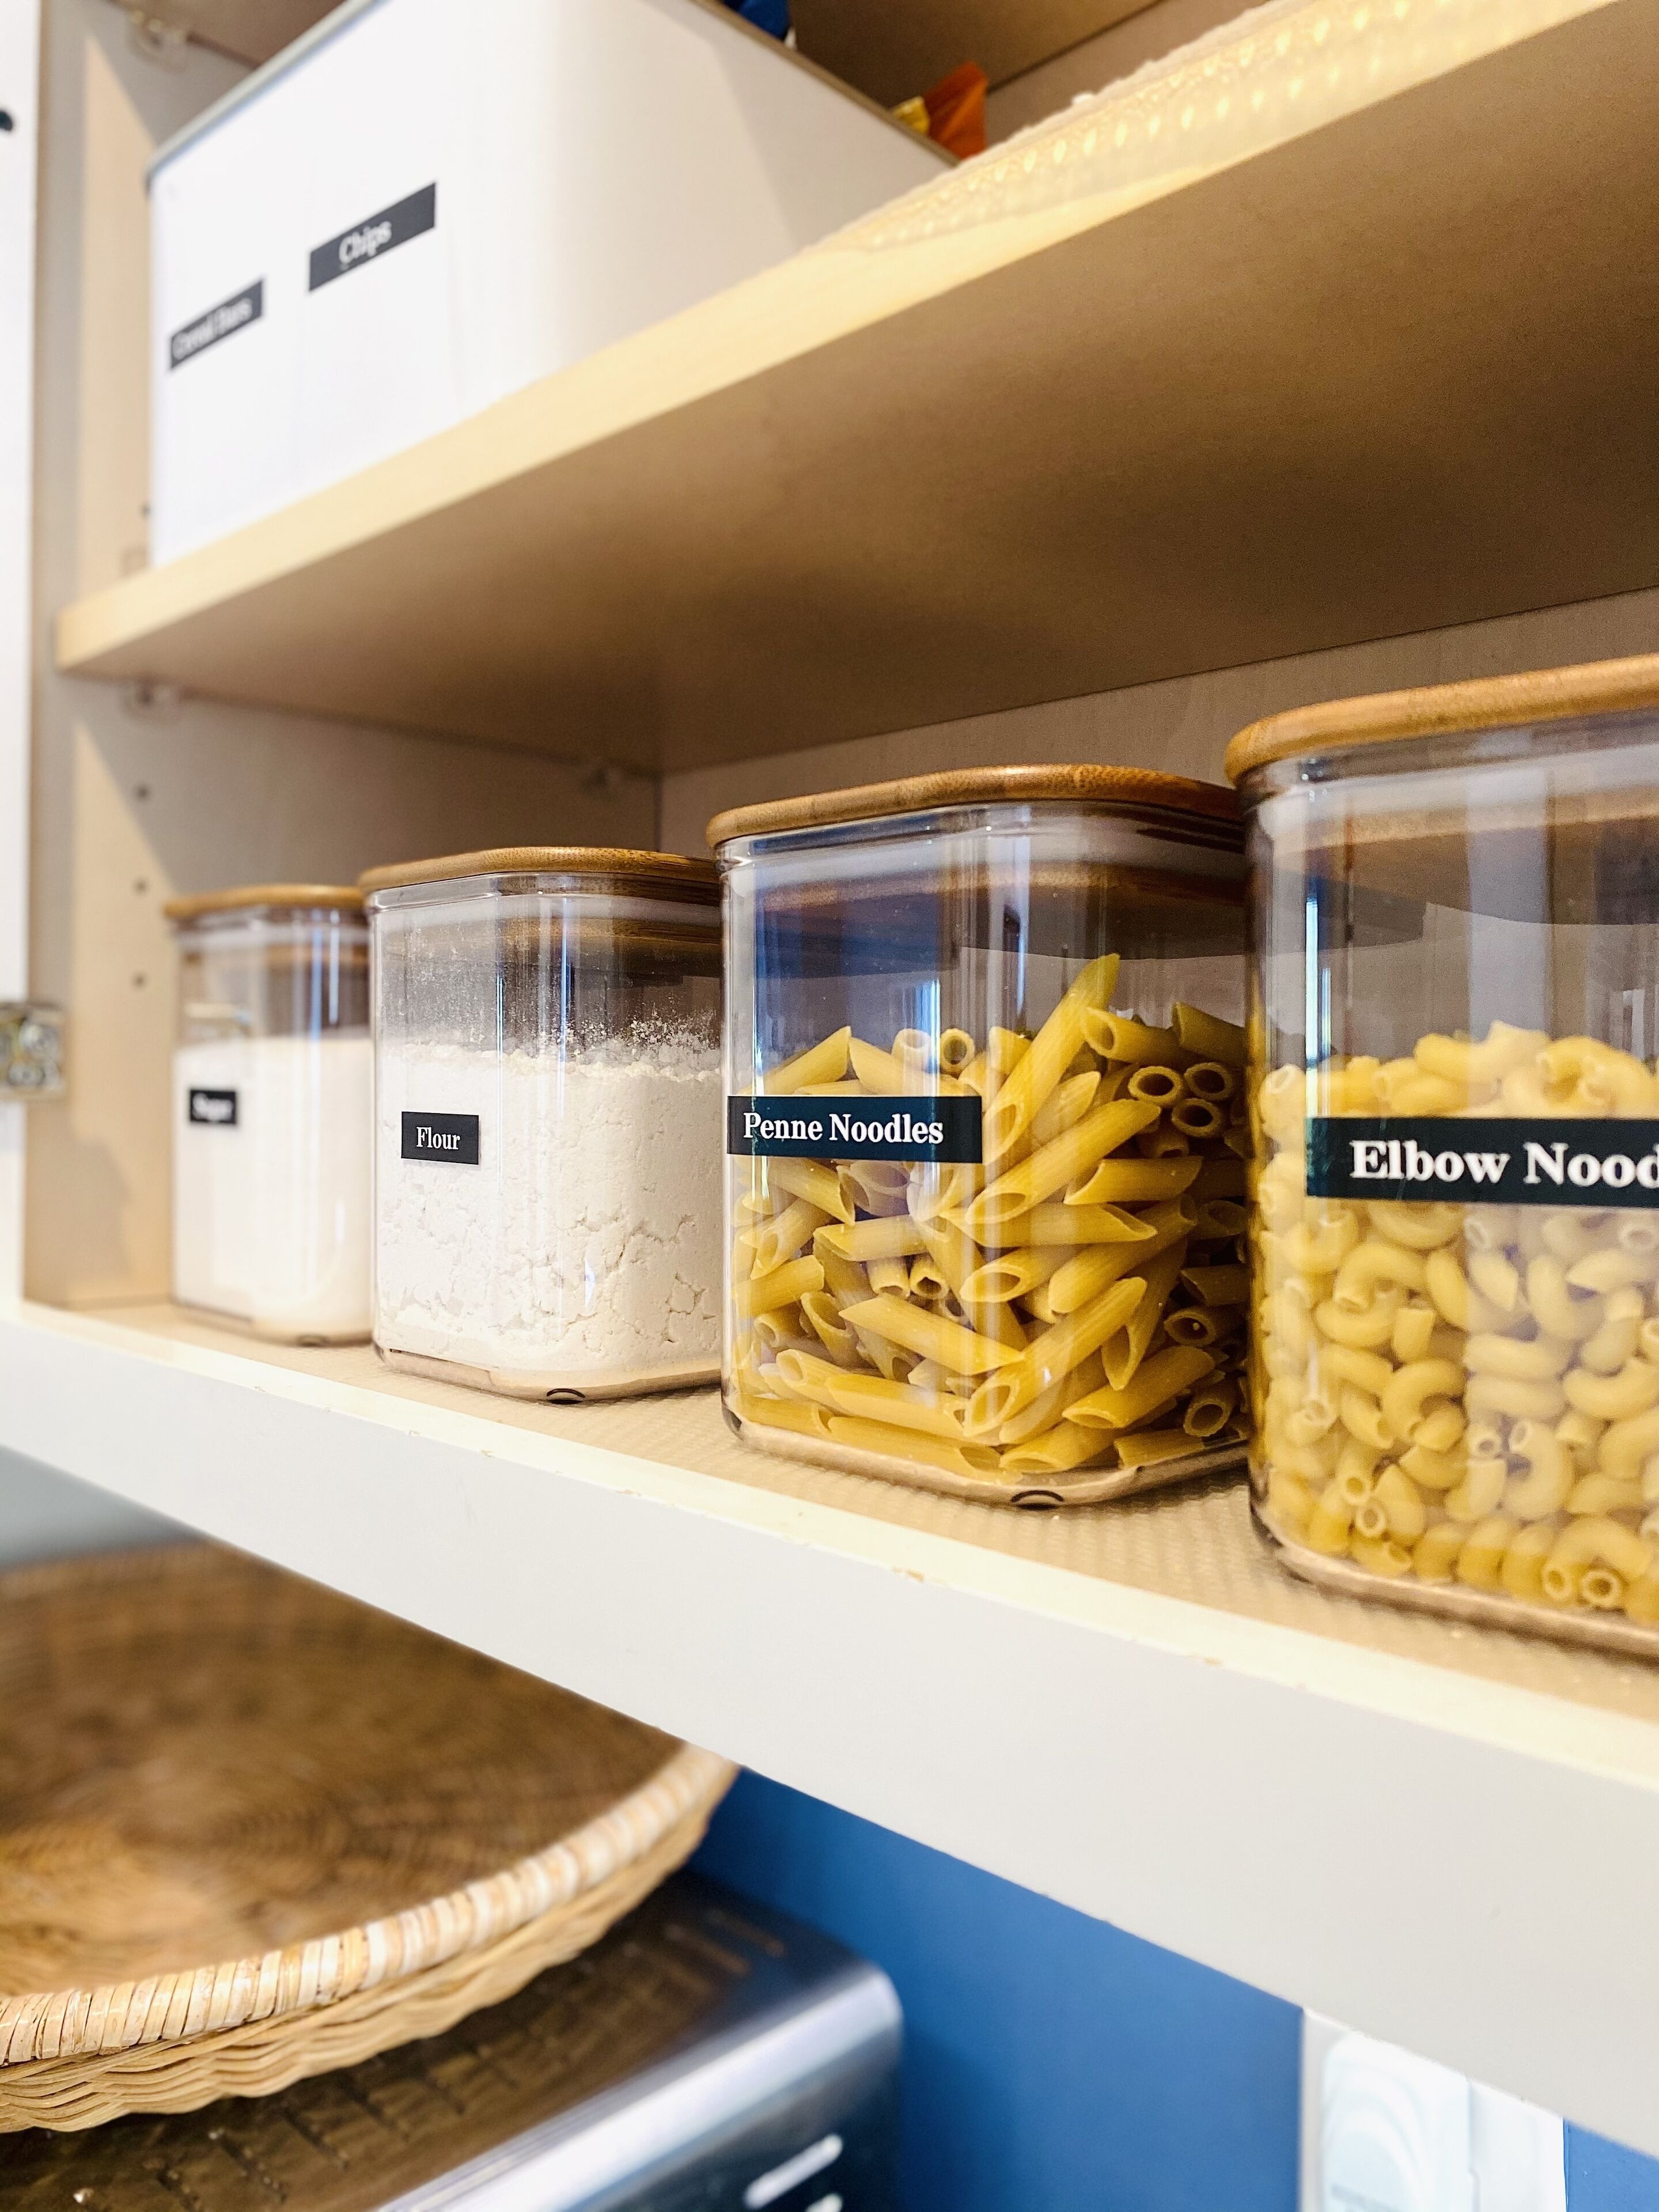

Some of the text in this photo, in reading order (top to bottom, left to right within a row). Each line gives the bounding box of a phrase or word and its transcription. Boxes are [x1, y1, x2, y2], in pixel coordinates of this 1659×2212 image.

[339, 220, 392, 264] Chips
[416, 1126, 461, 1150] Flour
[743, 1112, 944, 1144] Penne Noodles
[1349, 1139, 1510, 1183] Elbow
